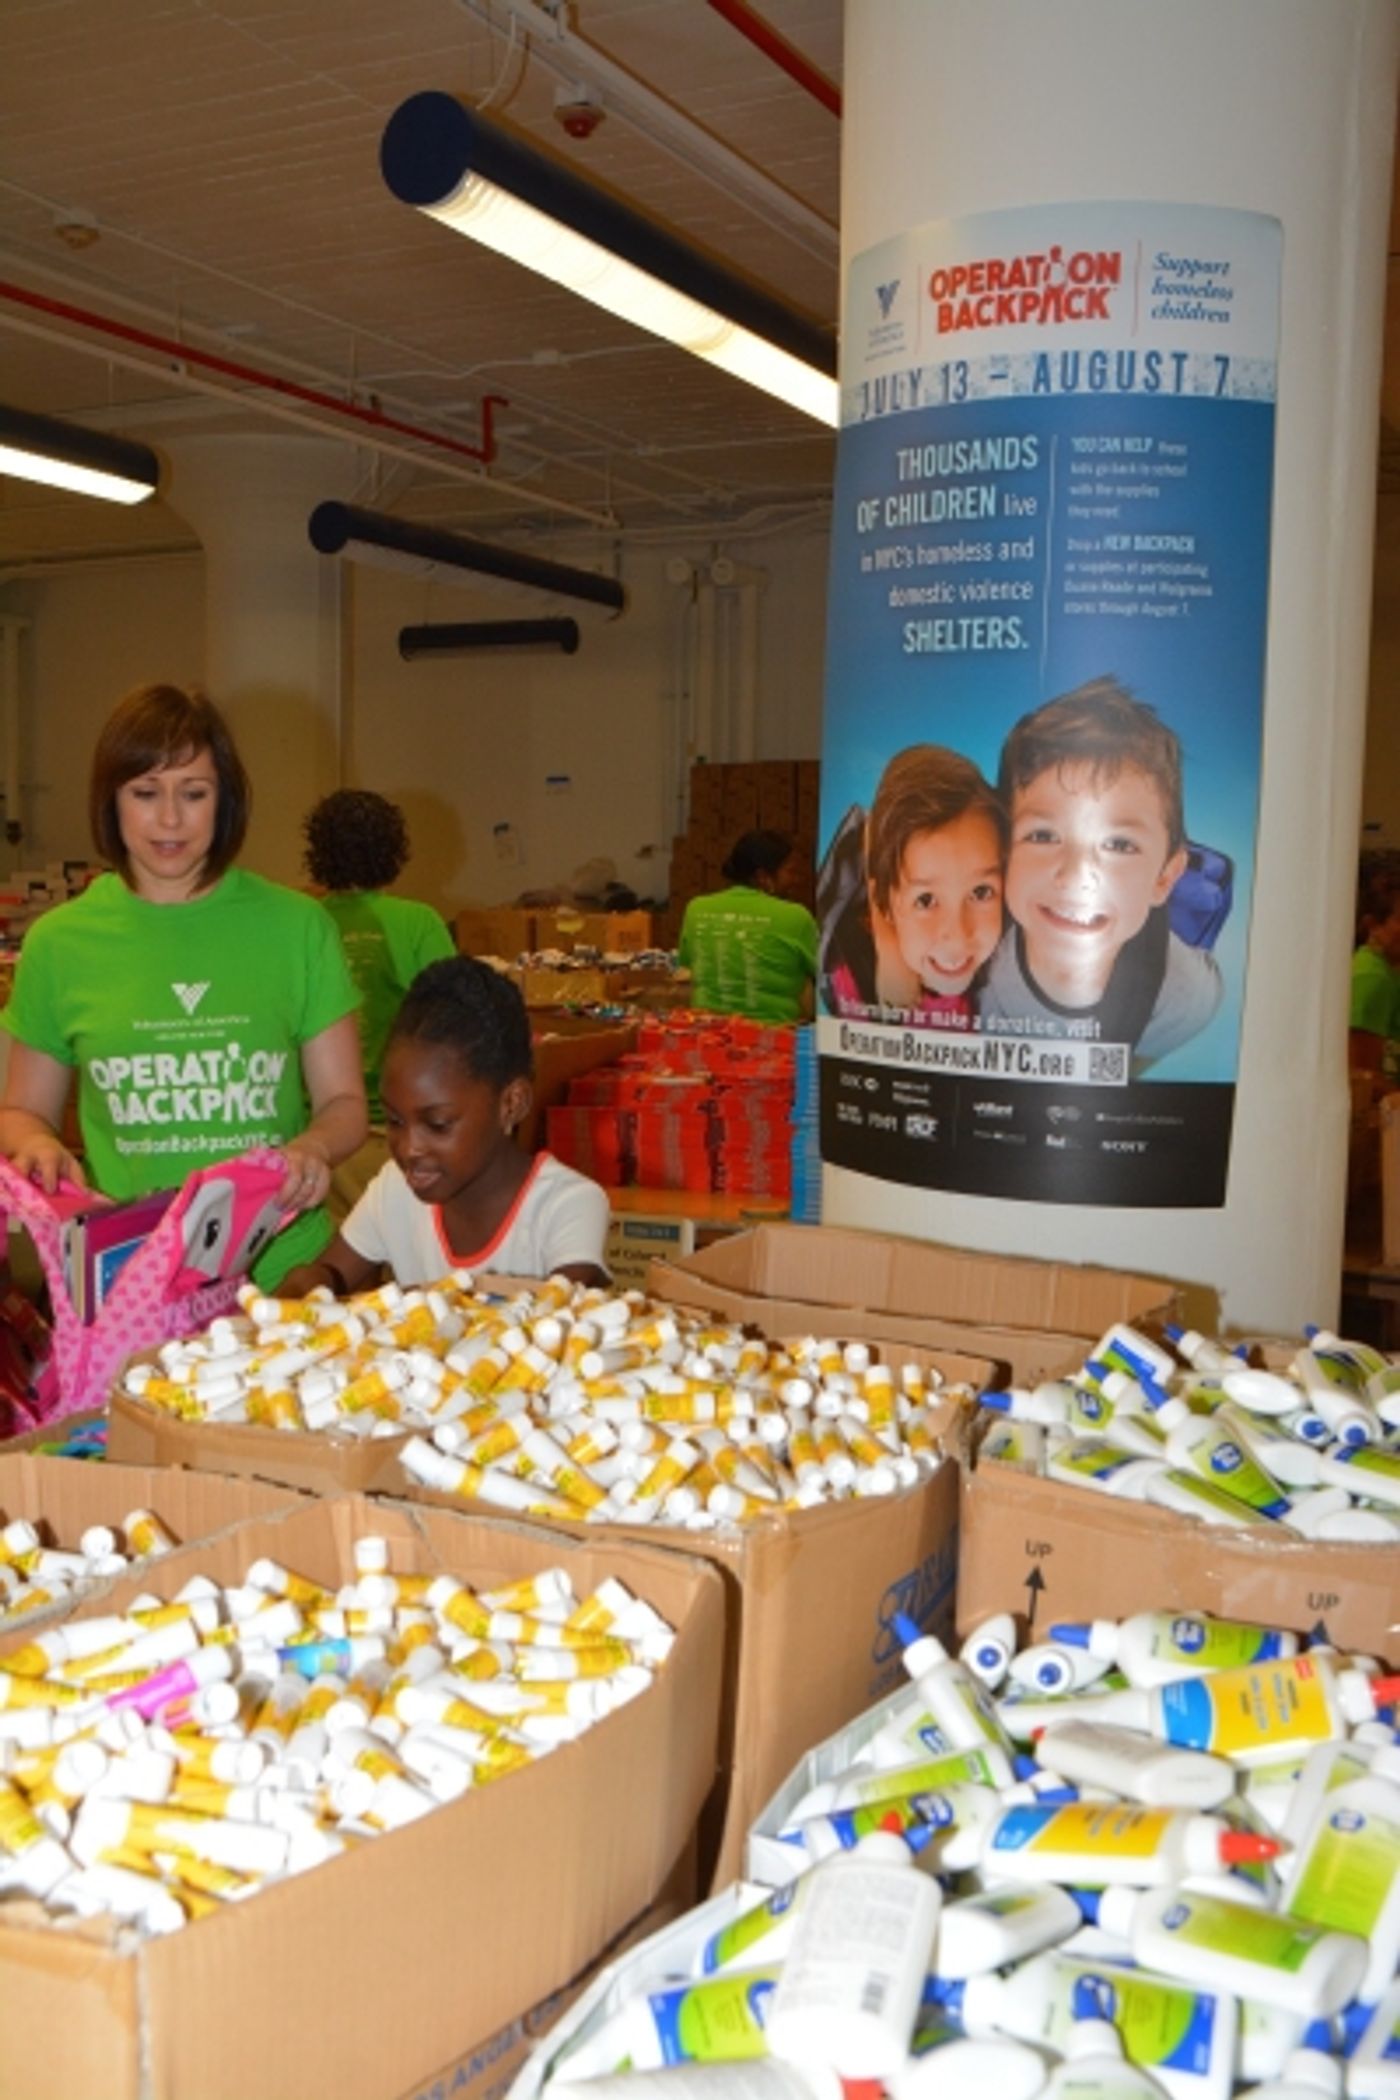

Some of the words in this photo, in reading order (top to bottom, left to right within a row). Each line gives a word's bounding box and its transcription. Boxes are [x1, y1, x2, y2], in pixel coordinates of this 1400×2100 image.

[930, 247, 1121, 301] OPERATION
[1153, 251, 1230, 278] Support
[937, 286, 1110, 334] BACKPACK
[1151, 275, 1234, 301] homeless
[1151, 298, 1230, 323] children
[861, 367, 922, 420] JULY
[941, 360, 968, 402] 13
[1032, 349, 1189, 394] AUGUST
[1214, 355, 1230, 395] 7
[897, 434, 1040, 482] THOUSANDS
[856, 498, 878, 533] OF
[885, 483, 996, 528] CHILDREN
[1003, 494, 1038, 518] live
[917, 538, 993, 567] homeless
[998, 535, 1035, 561] and
[888, 580, 957, 608] domestic
[959, 577, 1034, 603] violence
[903, 616, 1030, 654] SHELTERS.
[90, 1042, 288, 1091] OPERATION
[106, 1082, 278, 1126] BACKPACK
